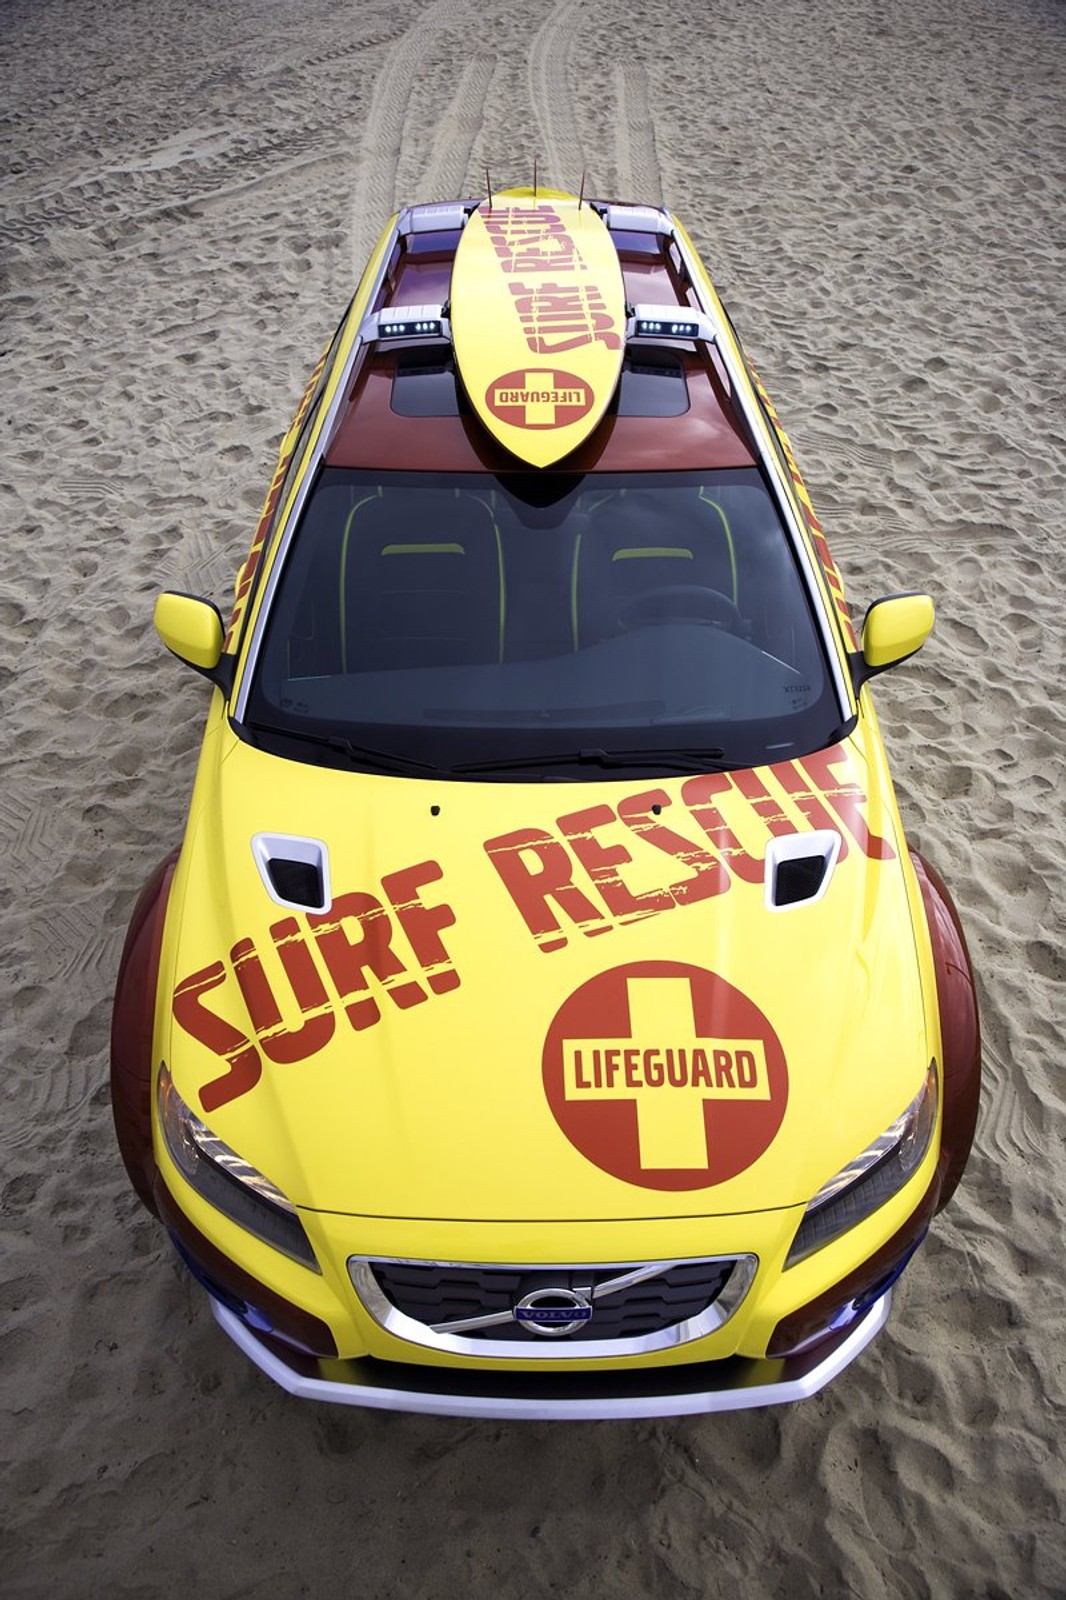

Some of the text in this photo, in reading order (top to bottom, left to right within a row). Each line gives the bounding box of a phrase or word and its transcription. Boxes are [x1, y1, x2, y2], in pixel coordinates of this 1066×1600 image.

[478, 205, 622, 354] SURF RESCUE
[499, 391, 581, 403] LIFEGUARD
[172, 743, 896, 1113] SURF RESCUE
[574, 1048, 758, 1090] LIFEGUARD
[520, 1310, 586, 1319] VOLVO
